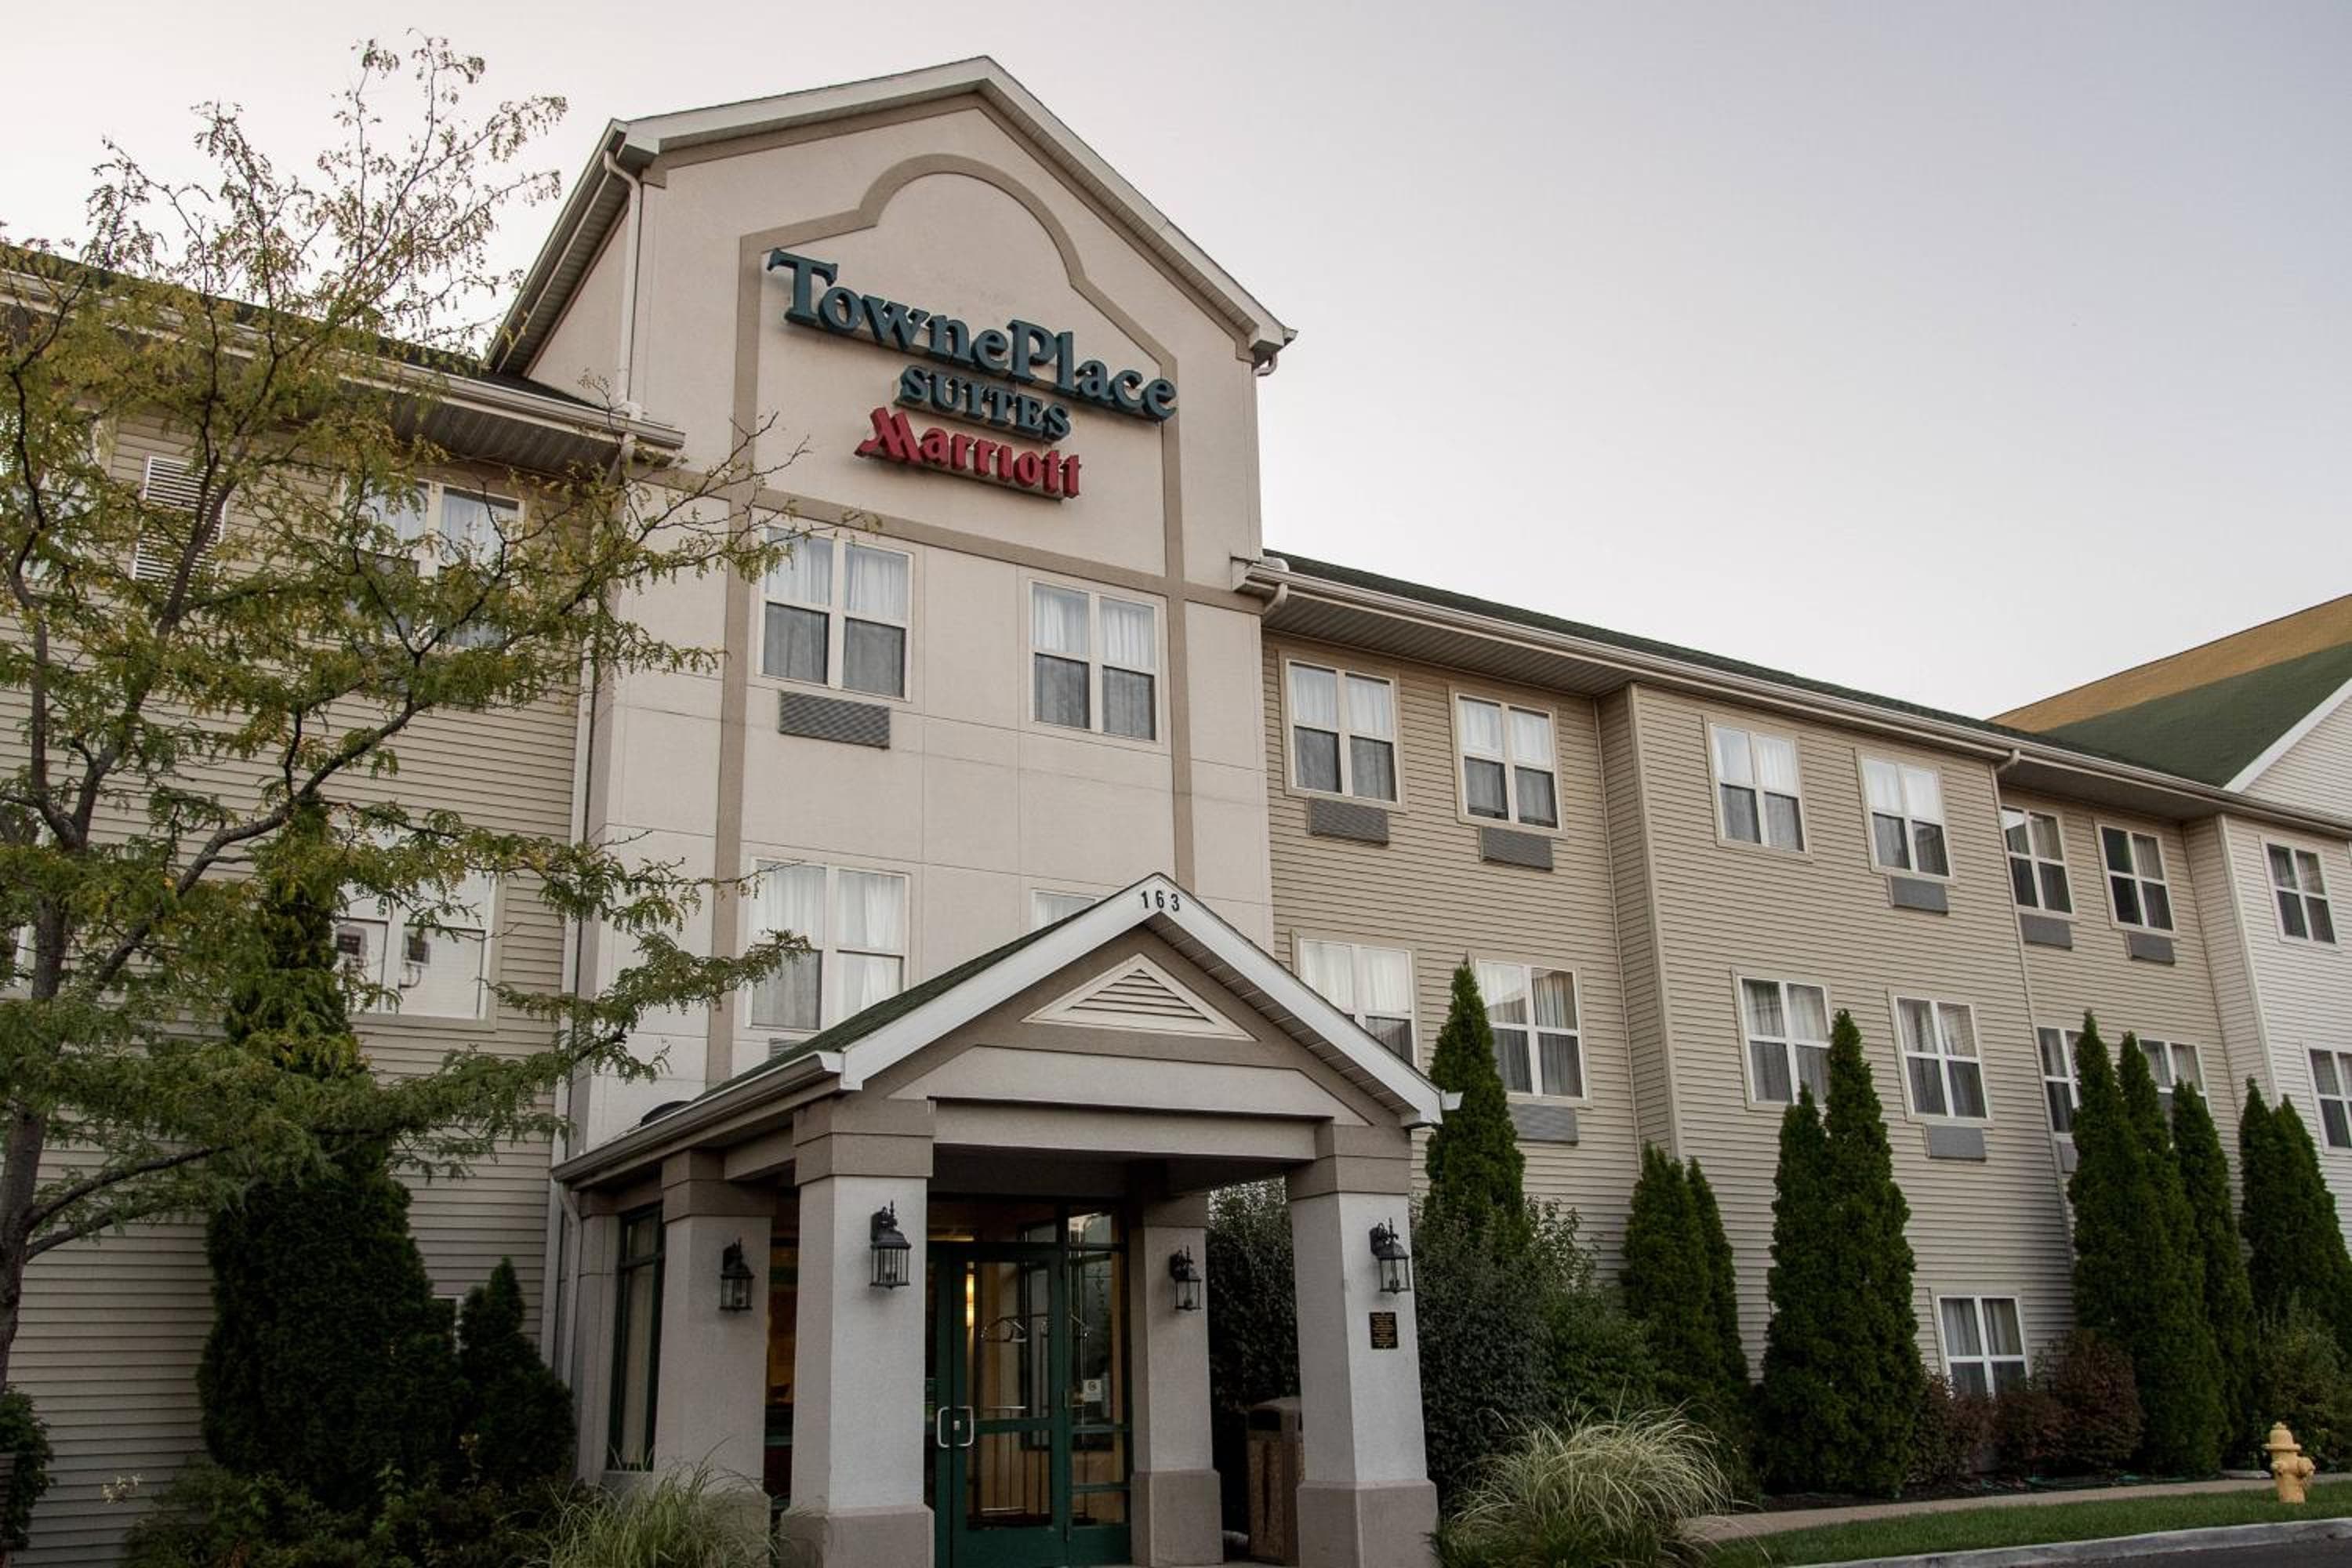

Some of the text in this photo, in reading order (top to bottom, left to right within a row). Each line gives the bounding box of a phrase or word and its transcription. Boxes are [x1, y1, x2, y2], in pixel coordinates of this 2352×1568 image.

[767, 249, 1178, 420] TownePlace
[898, 365, 1072, 441] SUITES
[855, 407, 1081, 498] Marriott
[1141, 890, 1179, 911] 163
